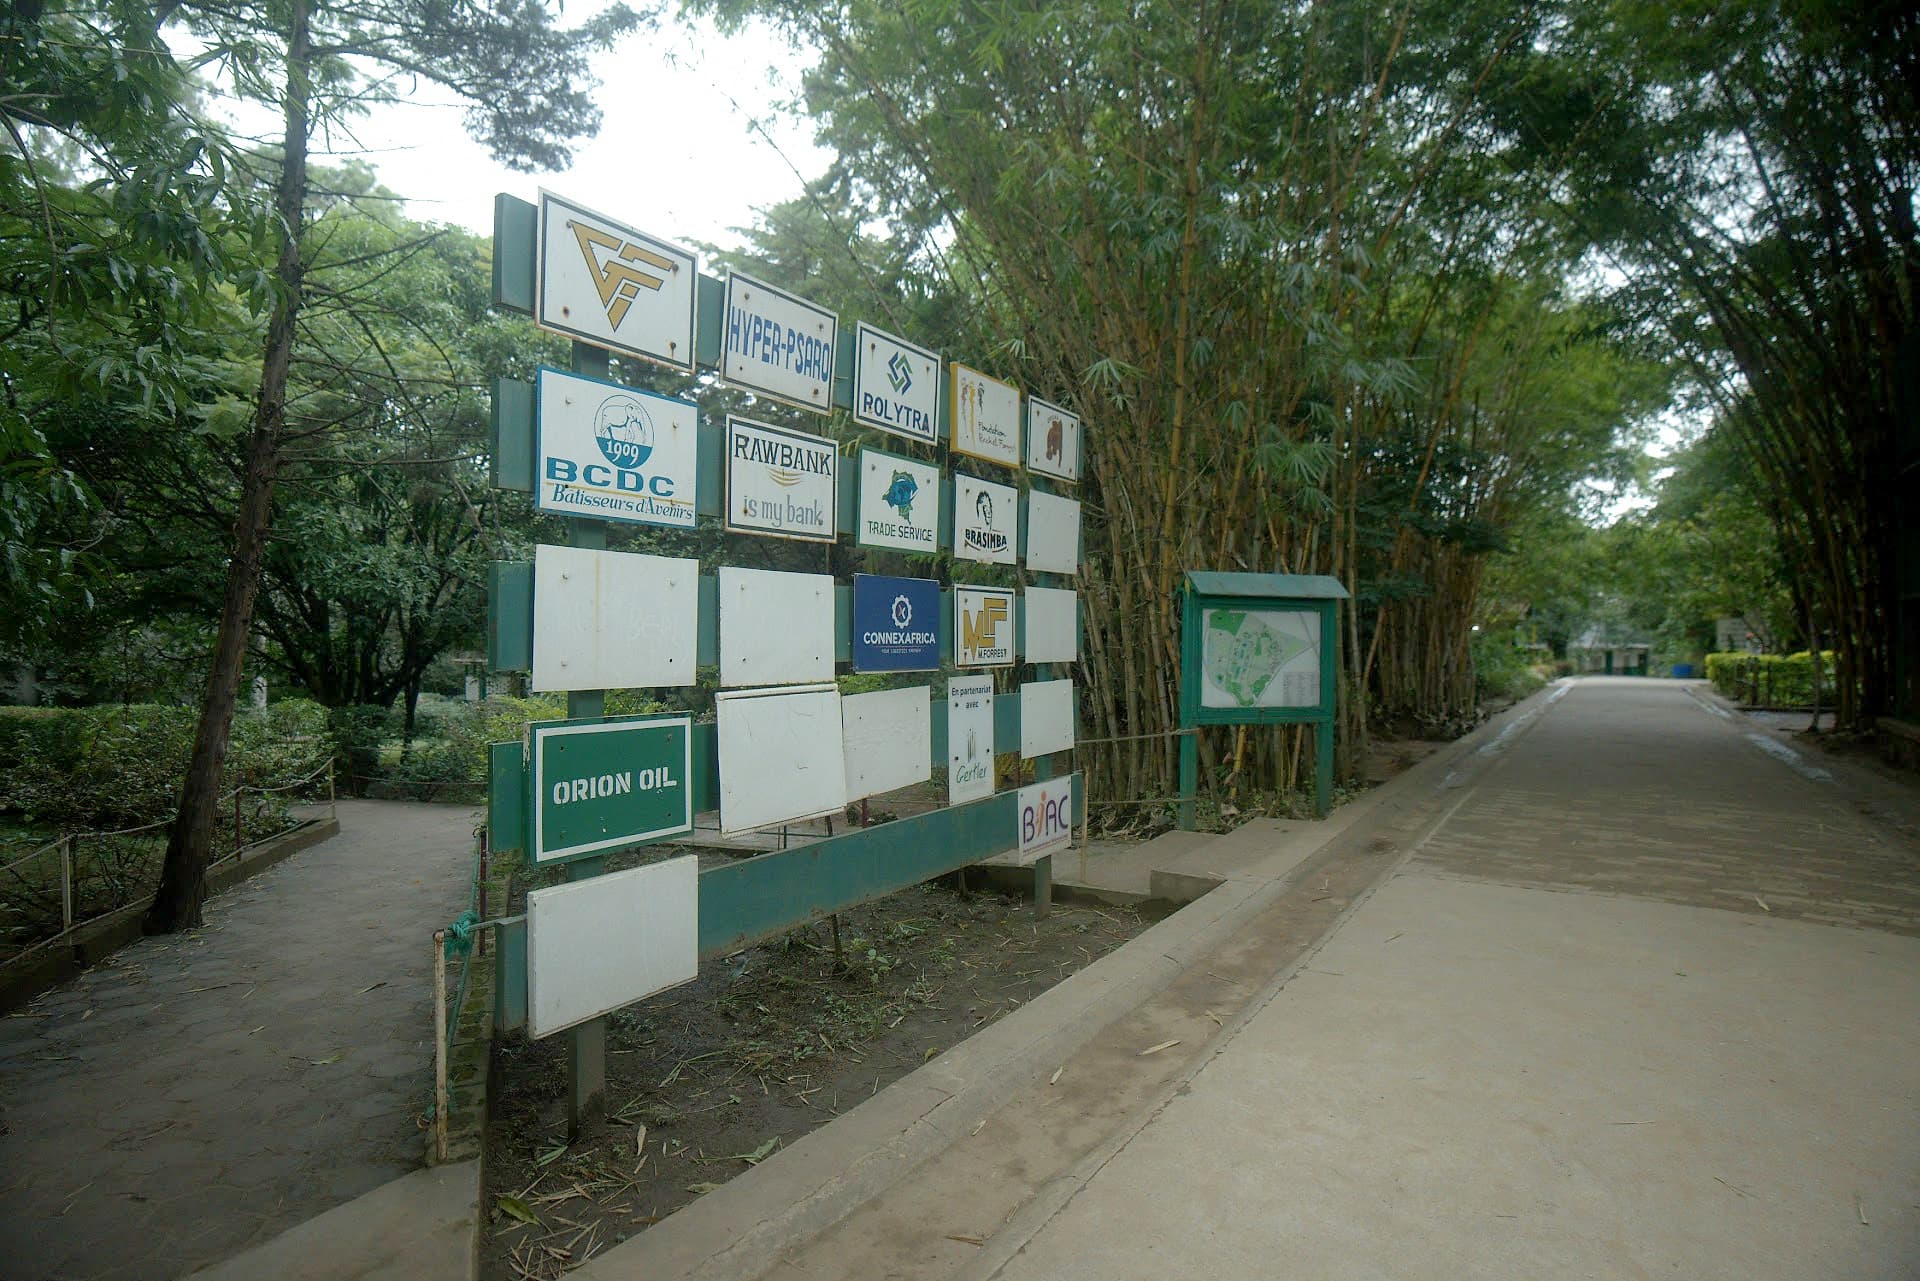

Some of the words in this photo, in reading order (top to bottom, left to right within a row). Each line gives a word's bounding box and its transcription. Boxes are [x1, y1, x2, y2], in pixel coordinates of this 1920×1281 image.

[729, 306, 831, 383] HYPER-PSARO
[606, 440, 639, 466] 1909
[734, 433, 832, 476] RAWBANK
[546, 456, 675, 497] BCDC
[743, 495, 757, 518] is
[761, 500, 783, 527] my
[787, 494, 823, 525] bank
[867, 520, 896, 537] TRADE
[898, 525, 932, 542] SERVICE
[965, 528, 1008, 549] BRASIMBA
[863, 632, 936, 645] CONNEXAFRICA
[951, 687, 959, 695] En
[960, 685, 991, 698] partenariat
[553, 772, 631, 805] ORION
[639, 766, 677, 790] OIL
